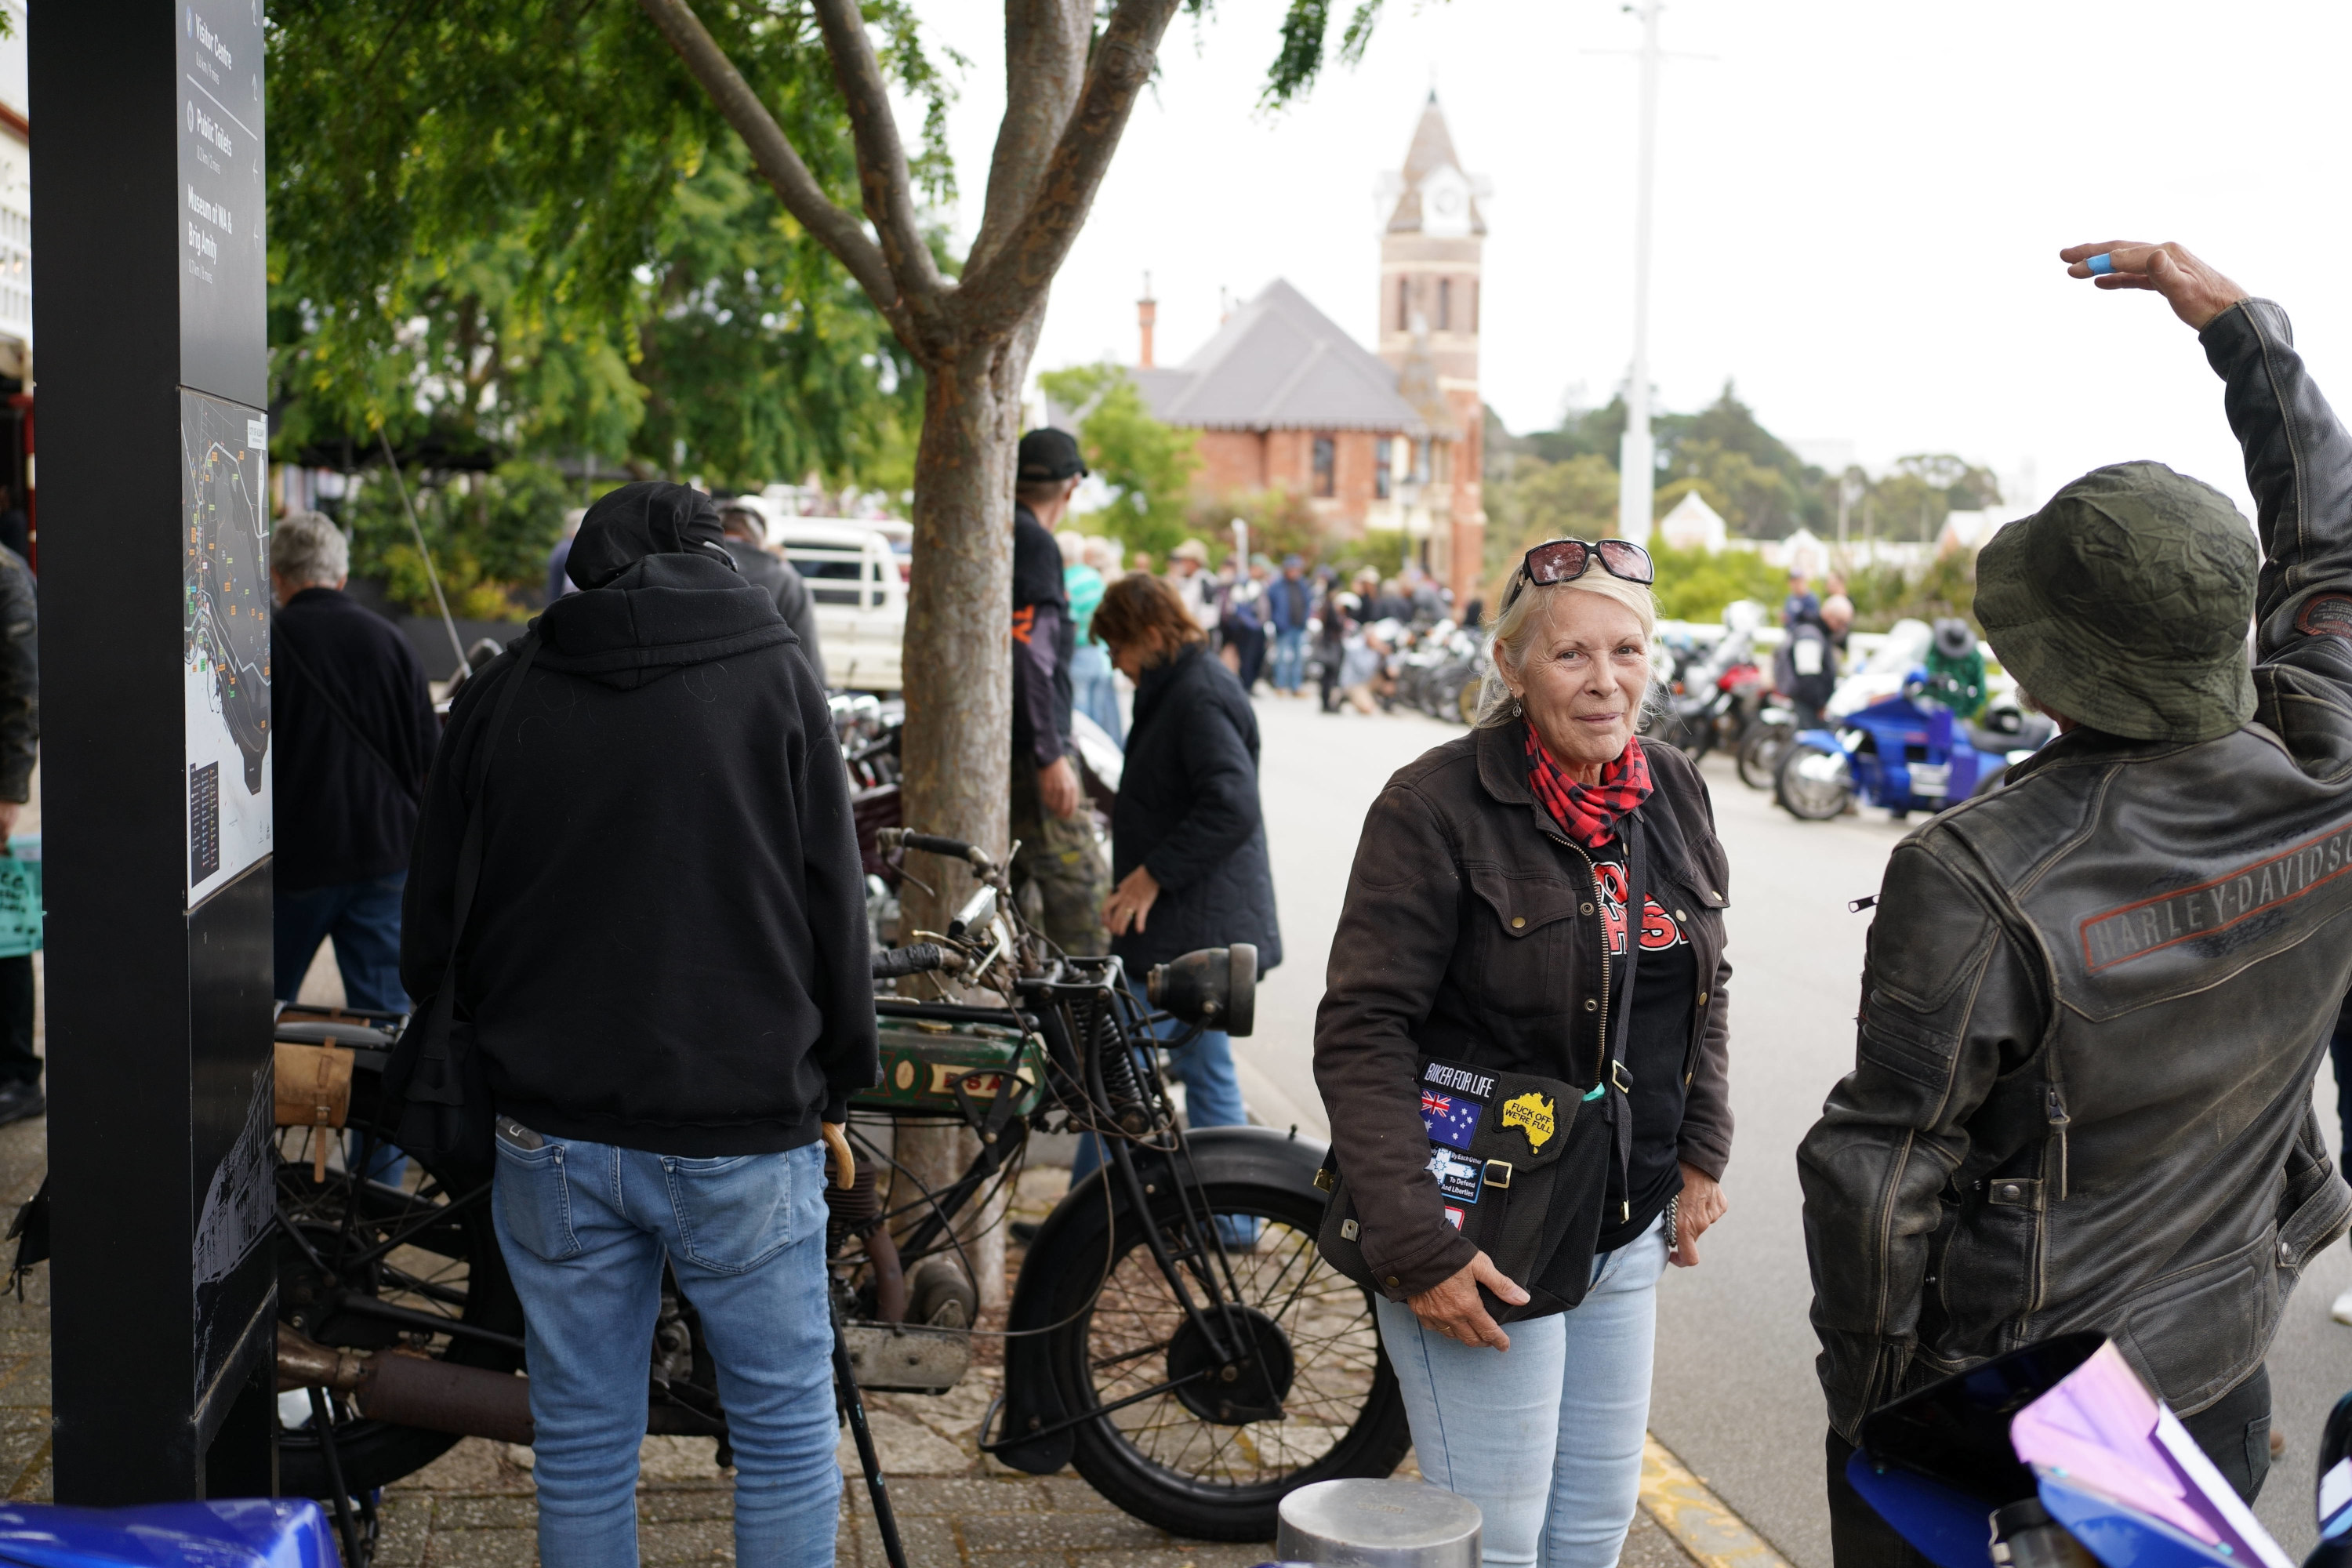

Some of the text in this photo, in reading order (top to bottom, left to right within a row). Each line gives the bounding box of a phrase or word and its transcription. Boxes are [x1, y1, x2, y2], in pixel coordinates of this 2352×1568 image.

[195, 13, 232, 71] Visitor Centre
[197, 107, 232, 158] Public Toilets
[188, 183, 232, 235] Museum of WA &
[188, 220, 217, 265] Brig Amity
[1424, 1062, 1495, 1098] BIKER FOR LIFE
[1505, 1109, 1551, 1134] WE'RE FULL
[1512, 1102, 1552, 1124] FUCK OFF
[1457, 1153, 1469, 1162] Each
[1469, 1156, 1483, 1165] Other
[1451, 1185, 1475, 1197] Liberties
[1456, 1178, 1475, 1189] Defend
